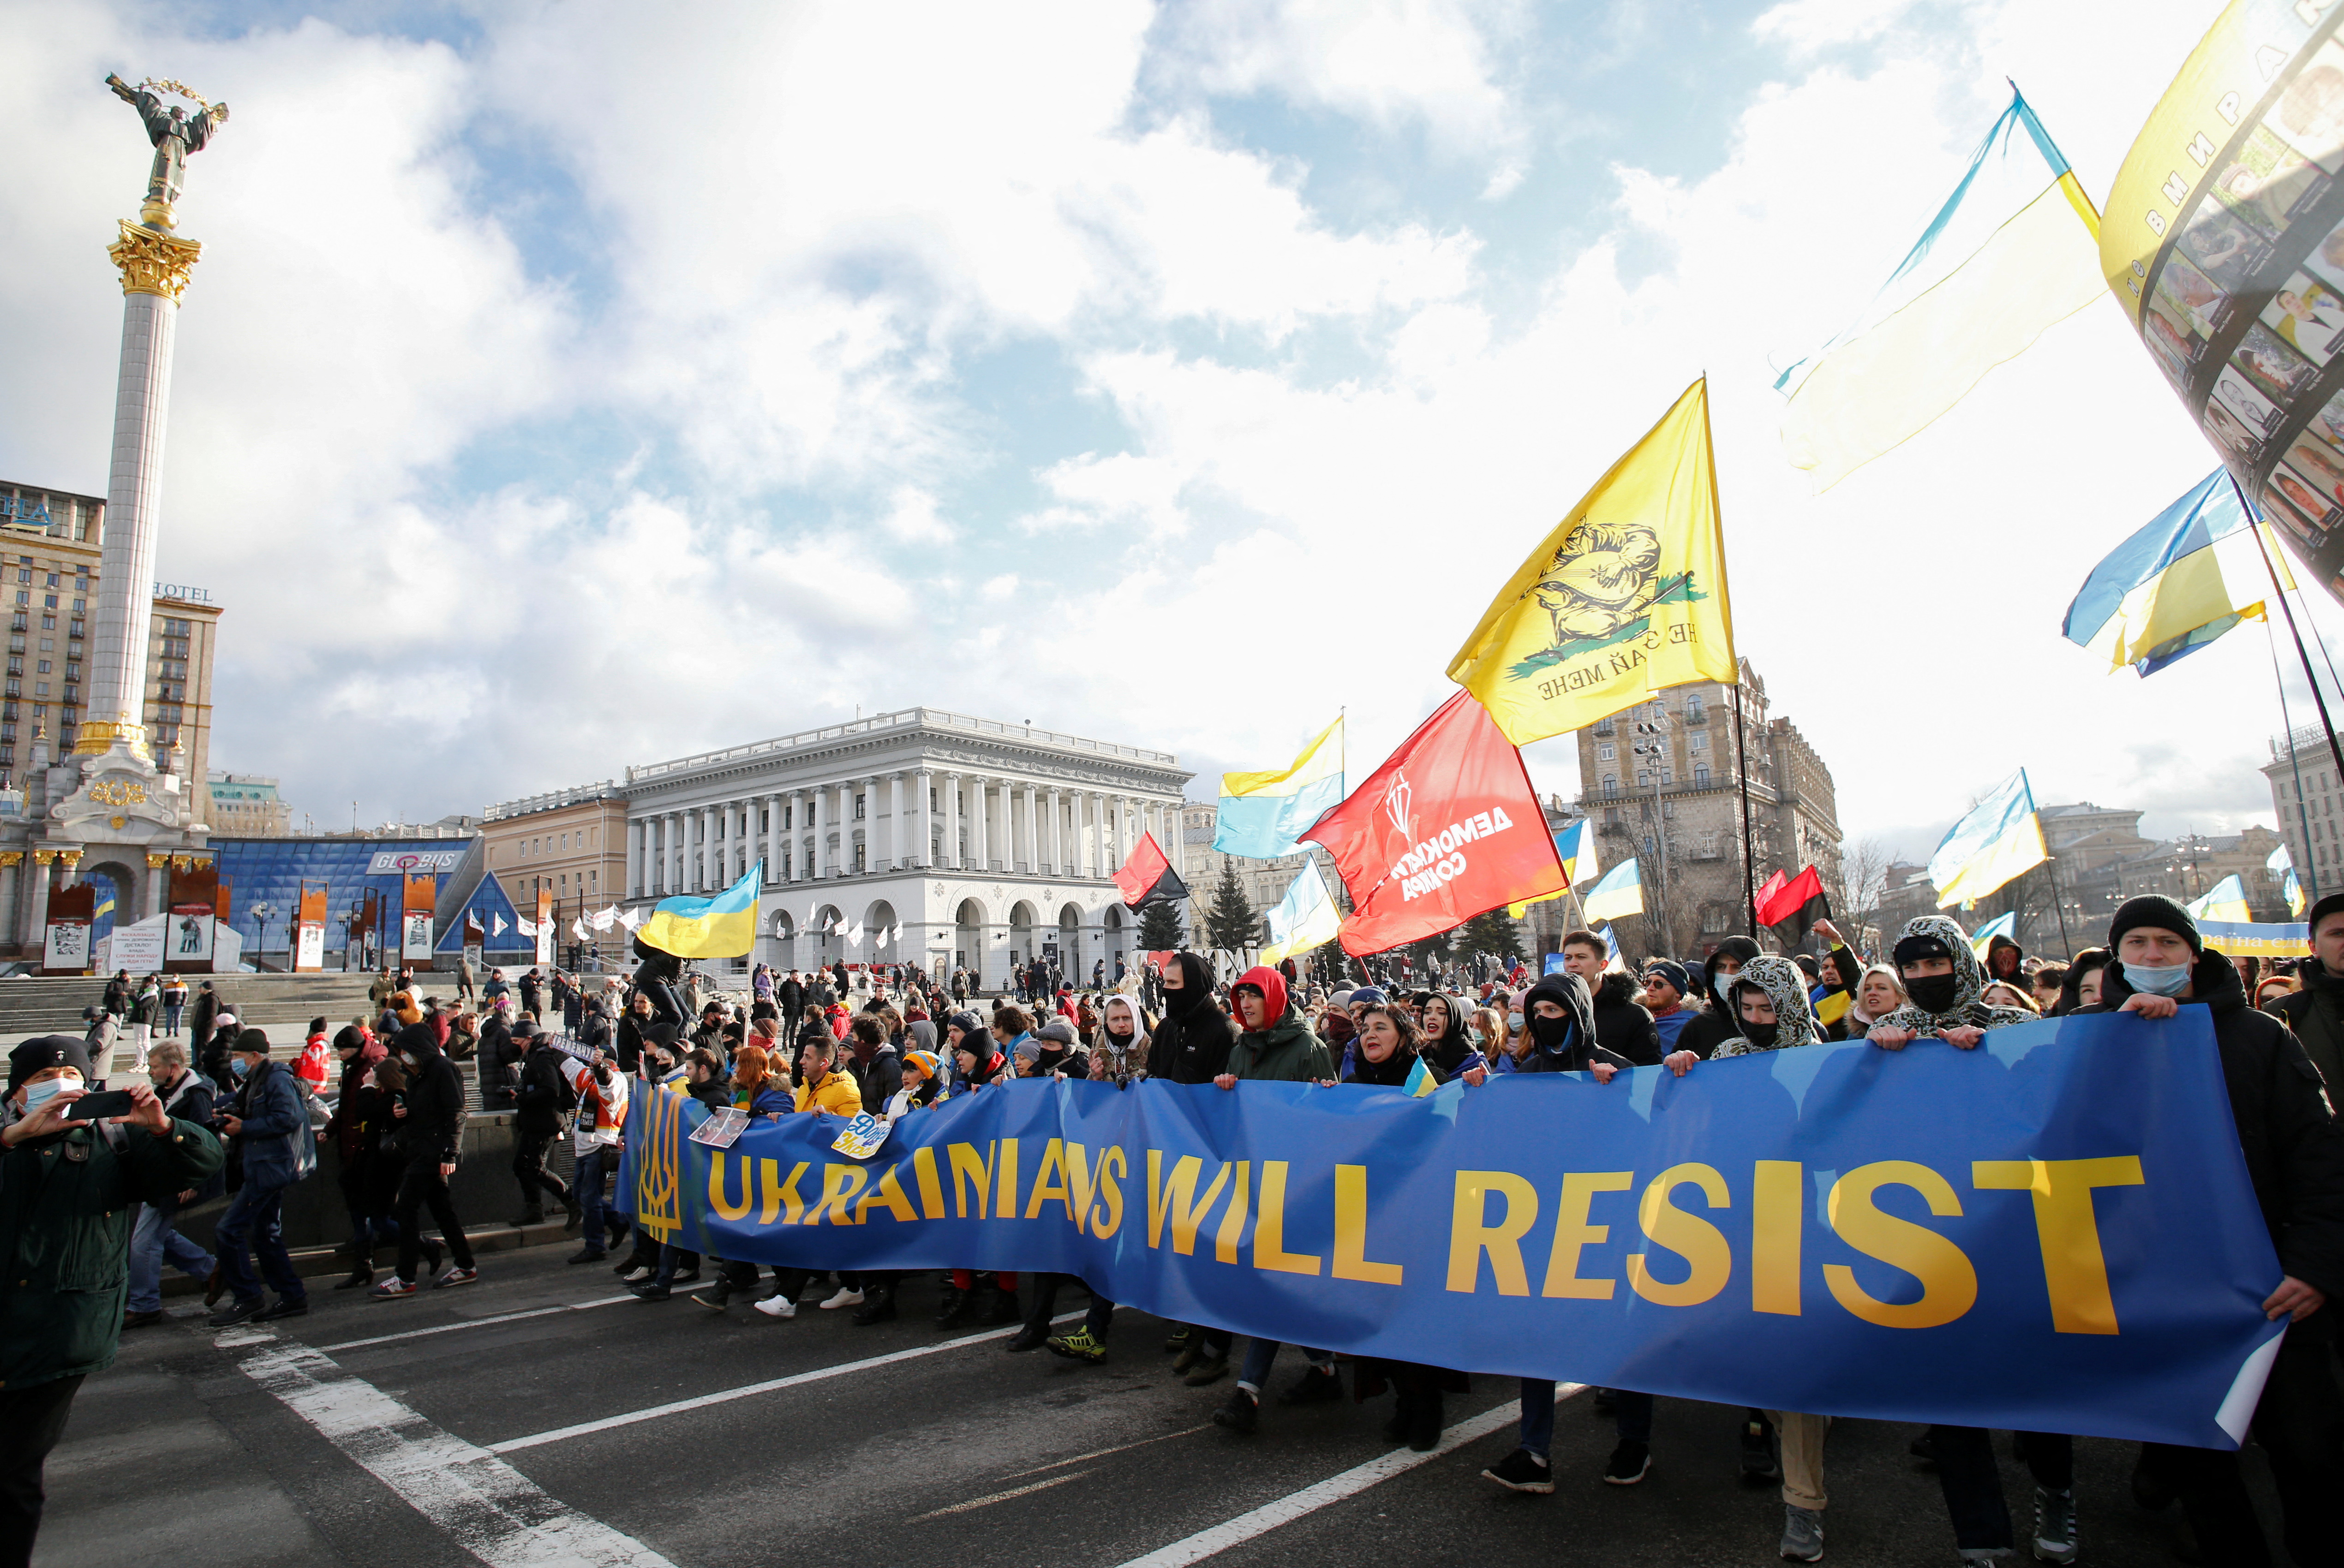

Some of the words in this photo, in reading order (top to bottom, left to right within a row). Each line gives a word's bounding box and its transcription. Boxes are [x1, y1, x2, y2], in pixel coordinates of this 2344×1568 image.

[0, 492, 54, 523] НА
[153, 582, 214, 602] HOTEL
[377, 854, 455, 869] GLOBUS
[2200, 931, 2262, 948] раїна
[709, 1138, 1127, 1239] UKRAINIANS
[1147, 1149, 1403, 1285] WILL
[1446, 1156, 2145, 1335] RESIST
